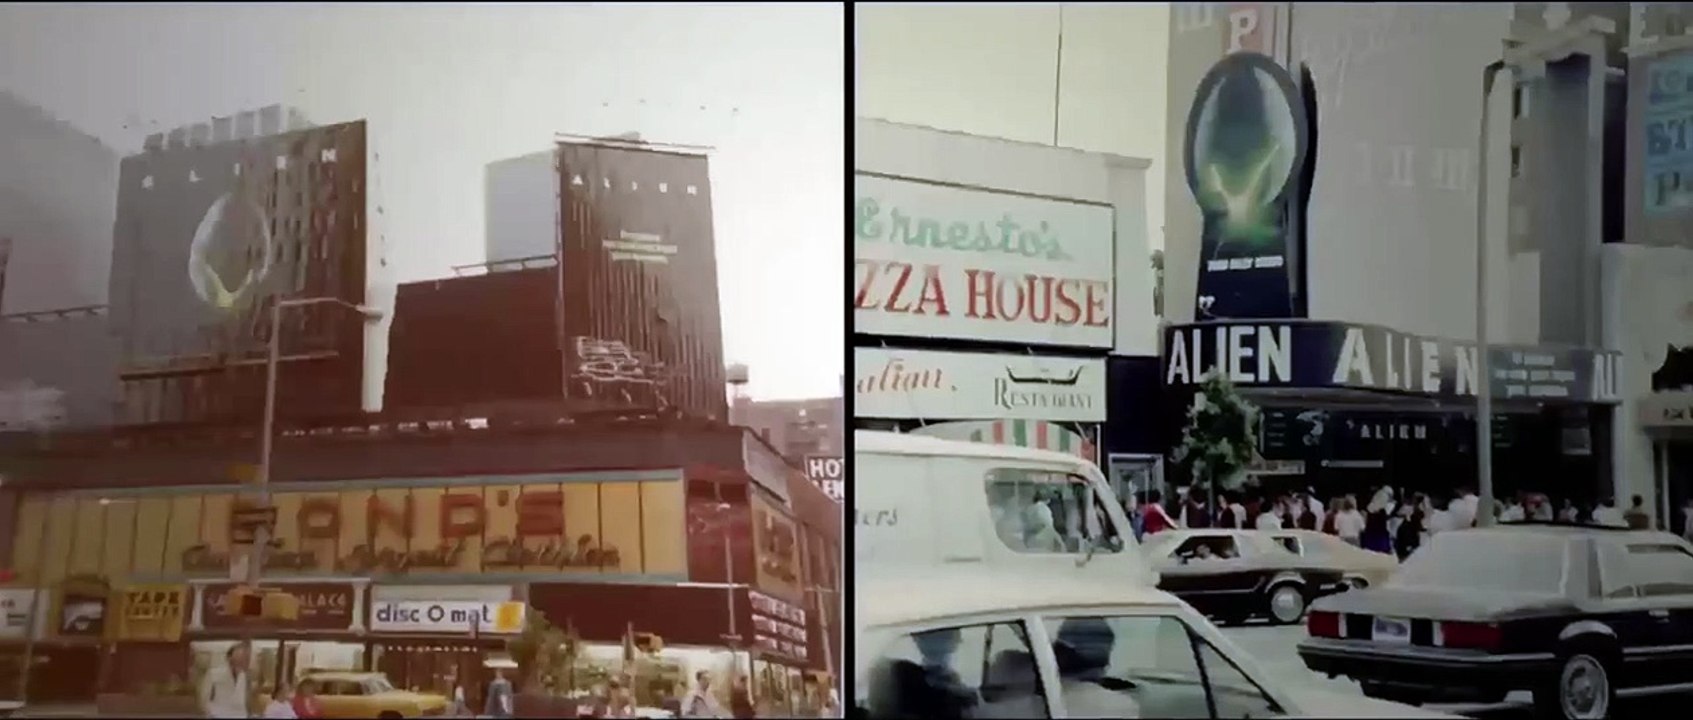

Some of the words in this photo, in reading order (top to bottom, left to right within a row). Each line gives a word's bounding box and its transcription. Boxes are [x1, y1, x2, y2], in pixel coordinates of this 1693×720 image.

[964, 268, 1109, 327] HOUSE
[1167, 325, 1292, 385] ALIEN
[1332, 328, 1478, 396] ALIEN
[376, 604, 420, 623] disc
[451, 605, 493, 623] mat
